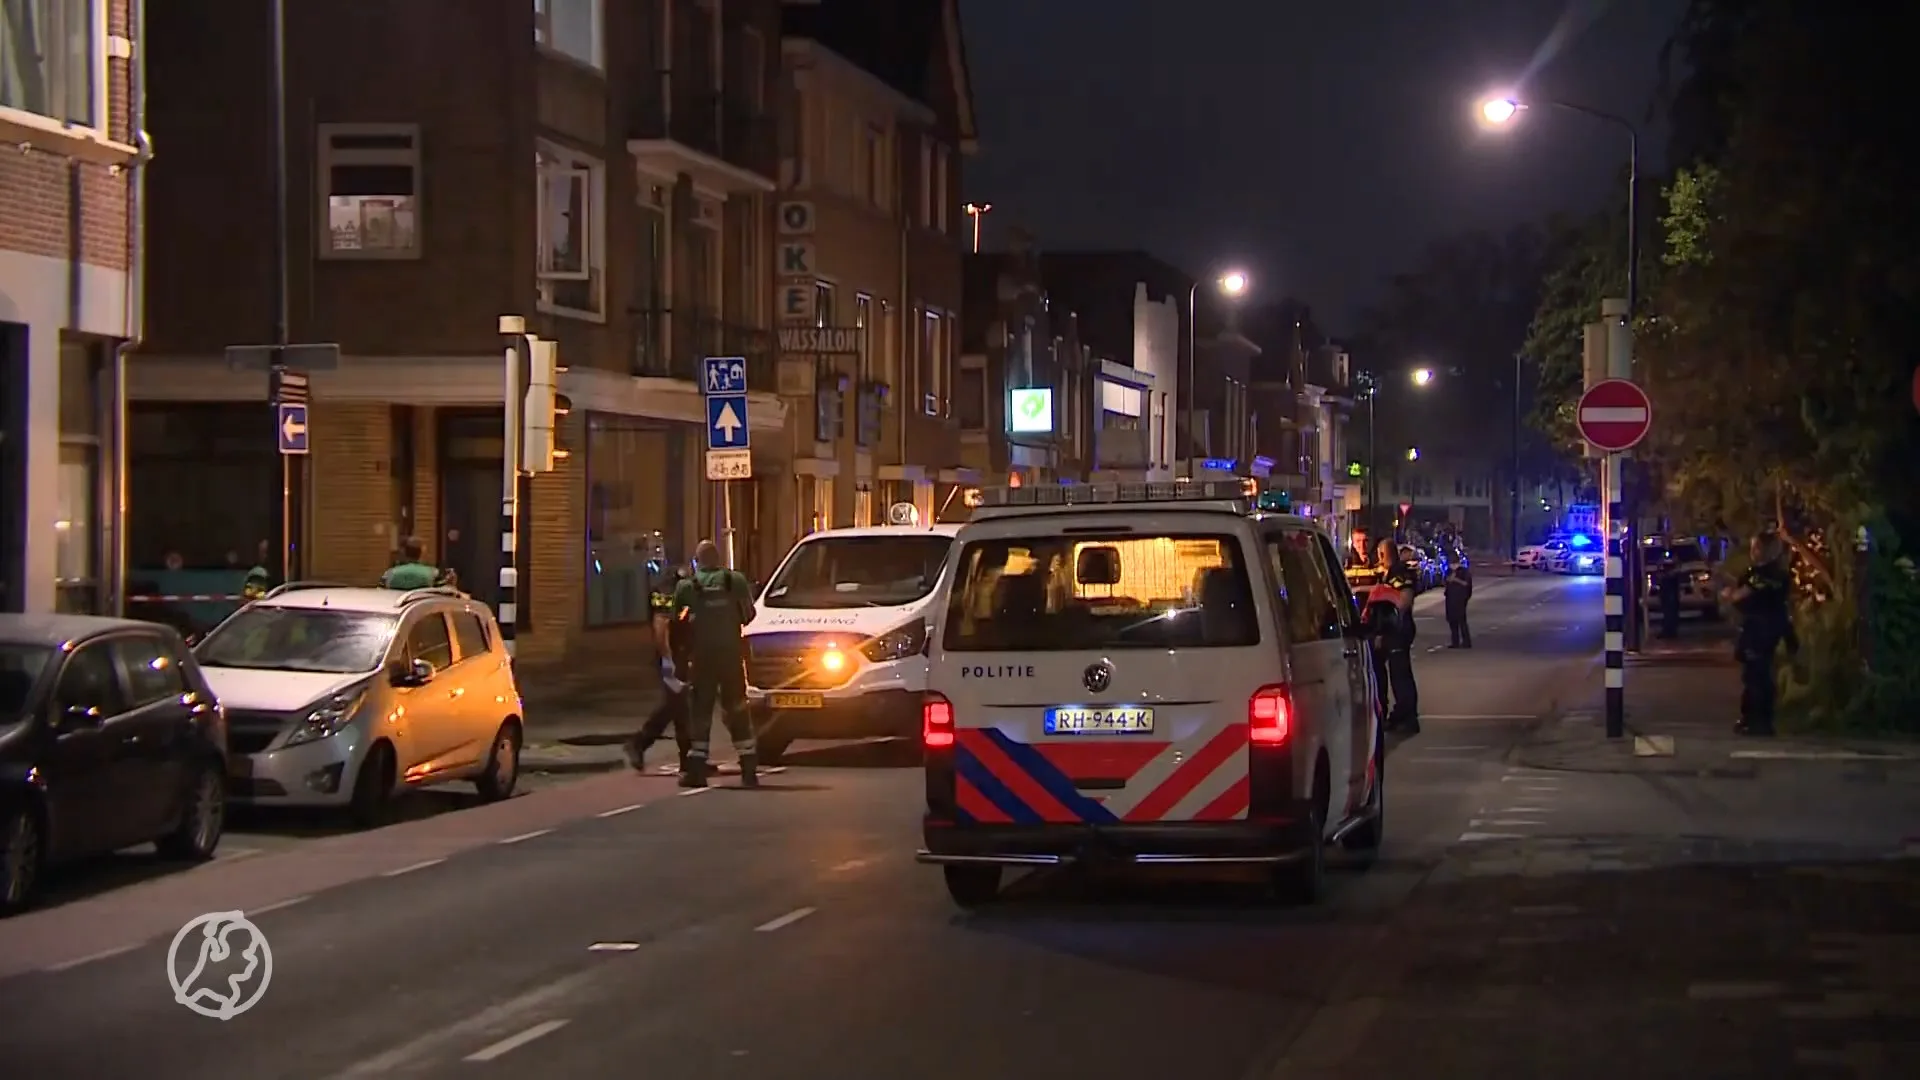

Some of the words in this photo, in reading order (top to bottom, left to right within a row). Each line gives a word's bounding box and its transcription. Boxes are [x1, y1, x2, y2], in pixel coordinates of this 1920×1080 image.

[778, 328, 857, 352] WASSALON
[961, 665, 1035, 678] POLITIE
[1059, 710, 1149, 729] RH-944-K
